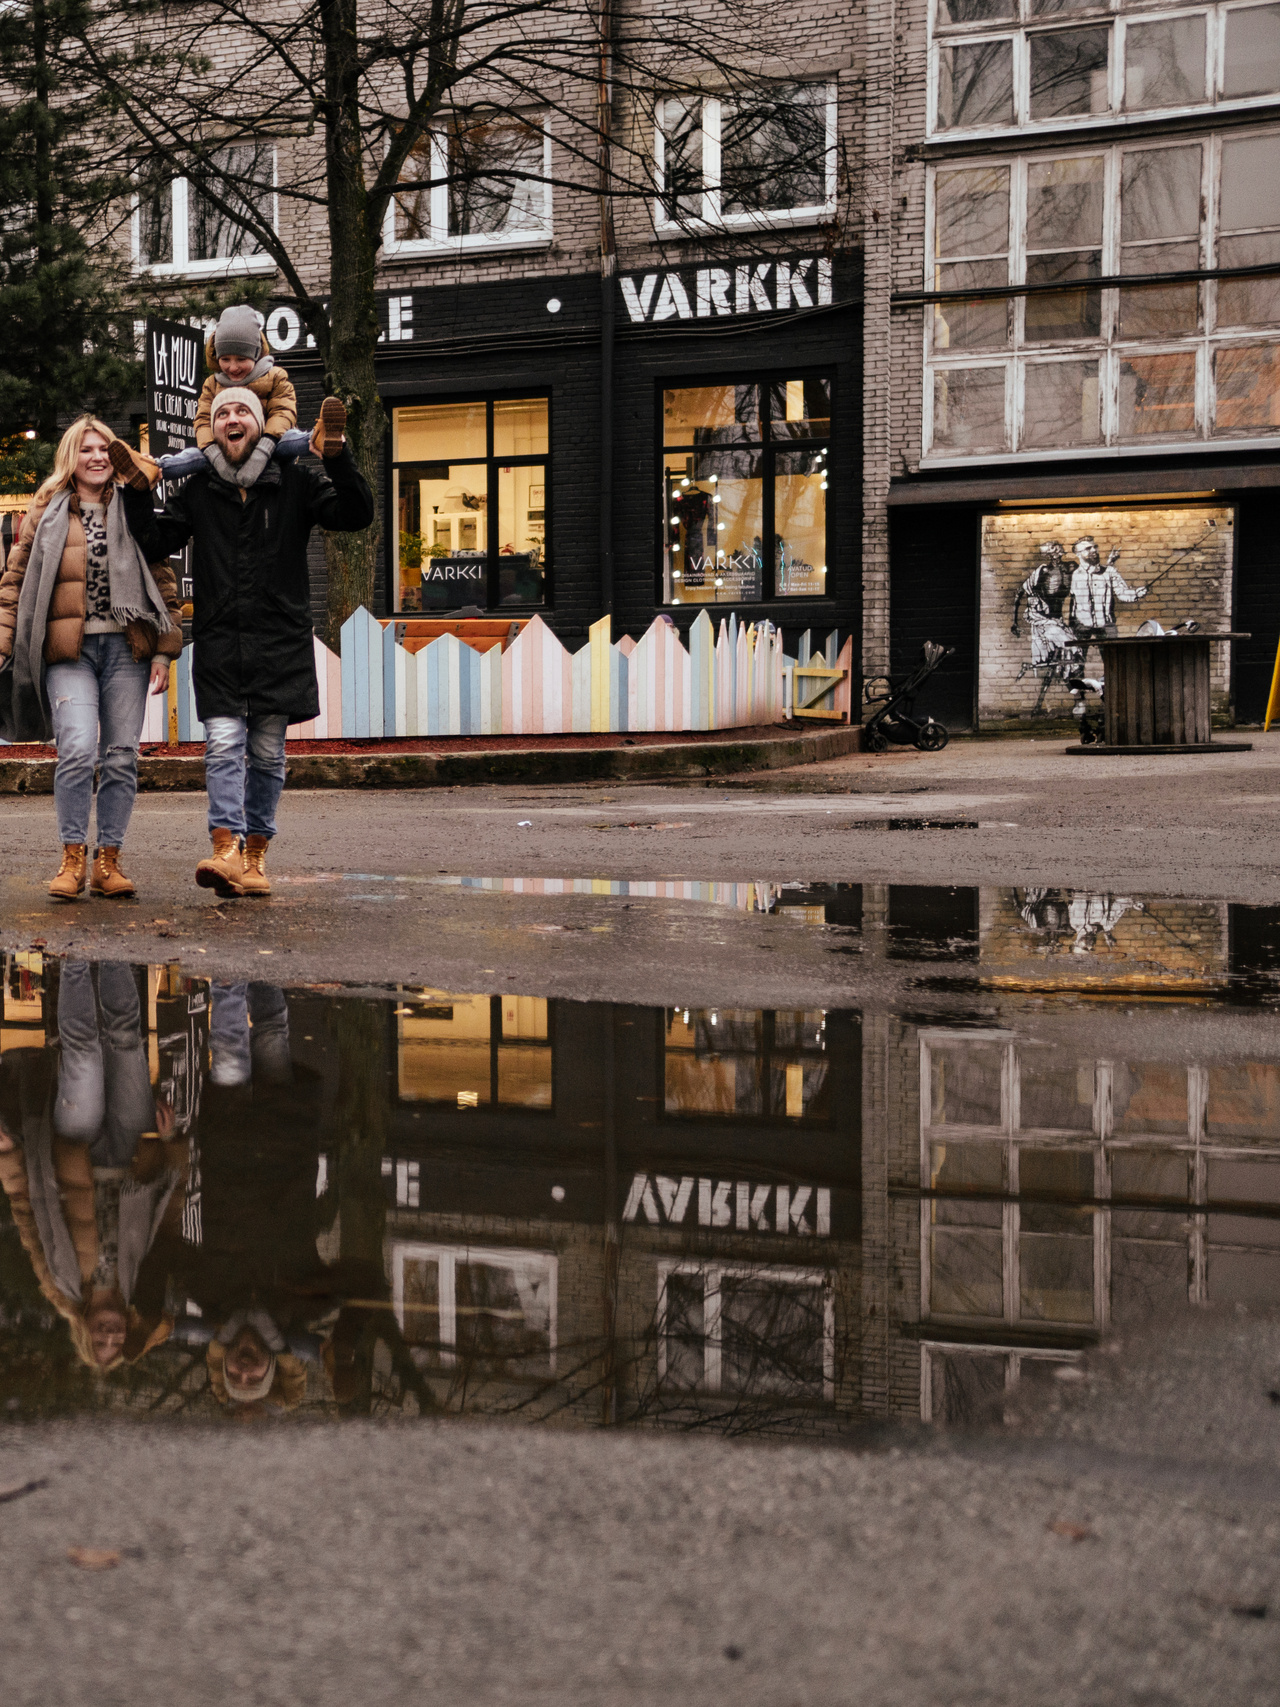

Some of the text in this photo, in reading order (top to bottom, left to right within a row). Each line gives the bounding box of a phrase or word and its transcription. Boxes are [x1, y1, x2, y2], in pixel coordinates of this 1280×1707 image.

[620, 257, 832, 323] VARKKI
[153, 331, 197, 389] LA MUU
[164, 393, 182, 417] CREAM
[183, 398, 198, 419] SHOP
[421, 565, 482, 581] VARKKI
[690, 554, 756, 570] VARKKI
